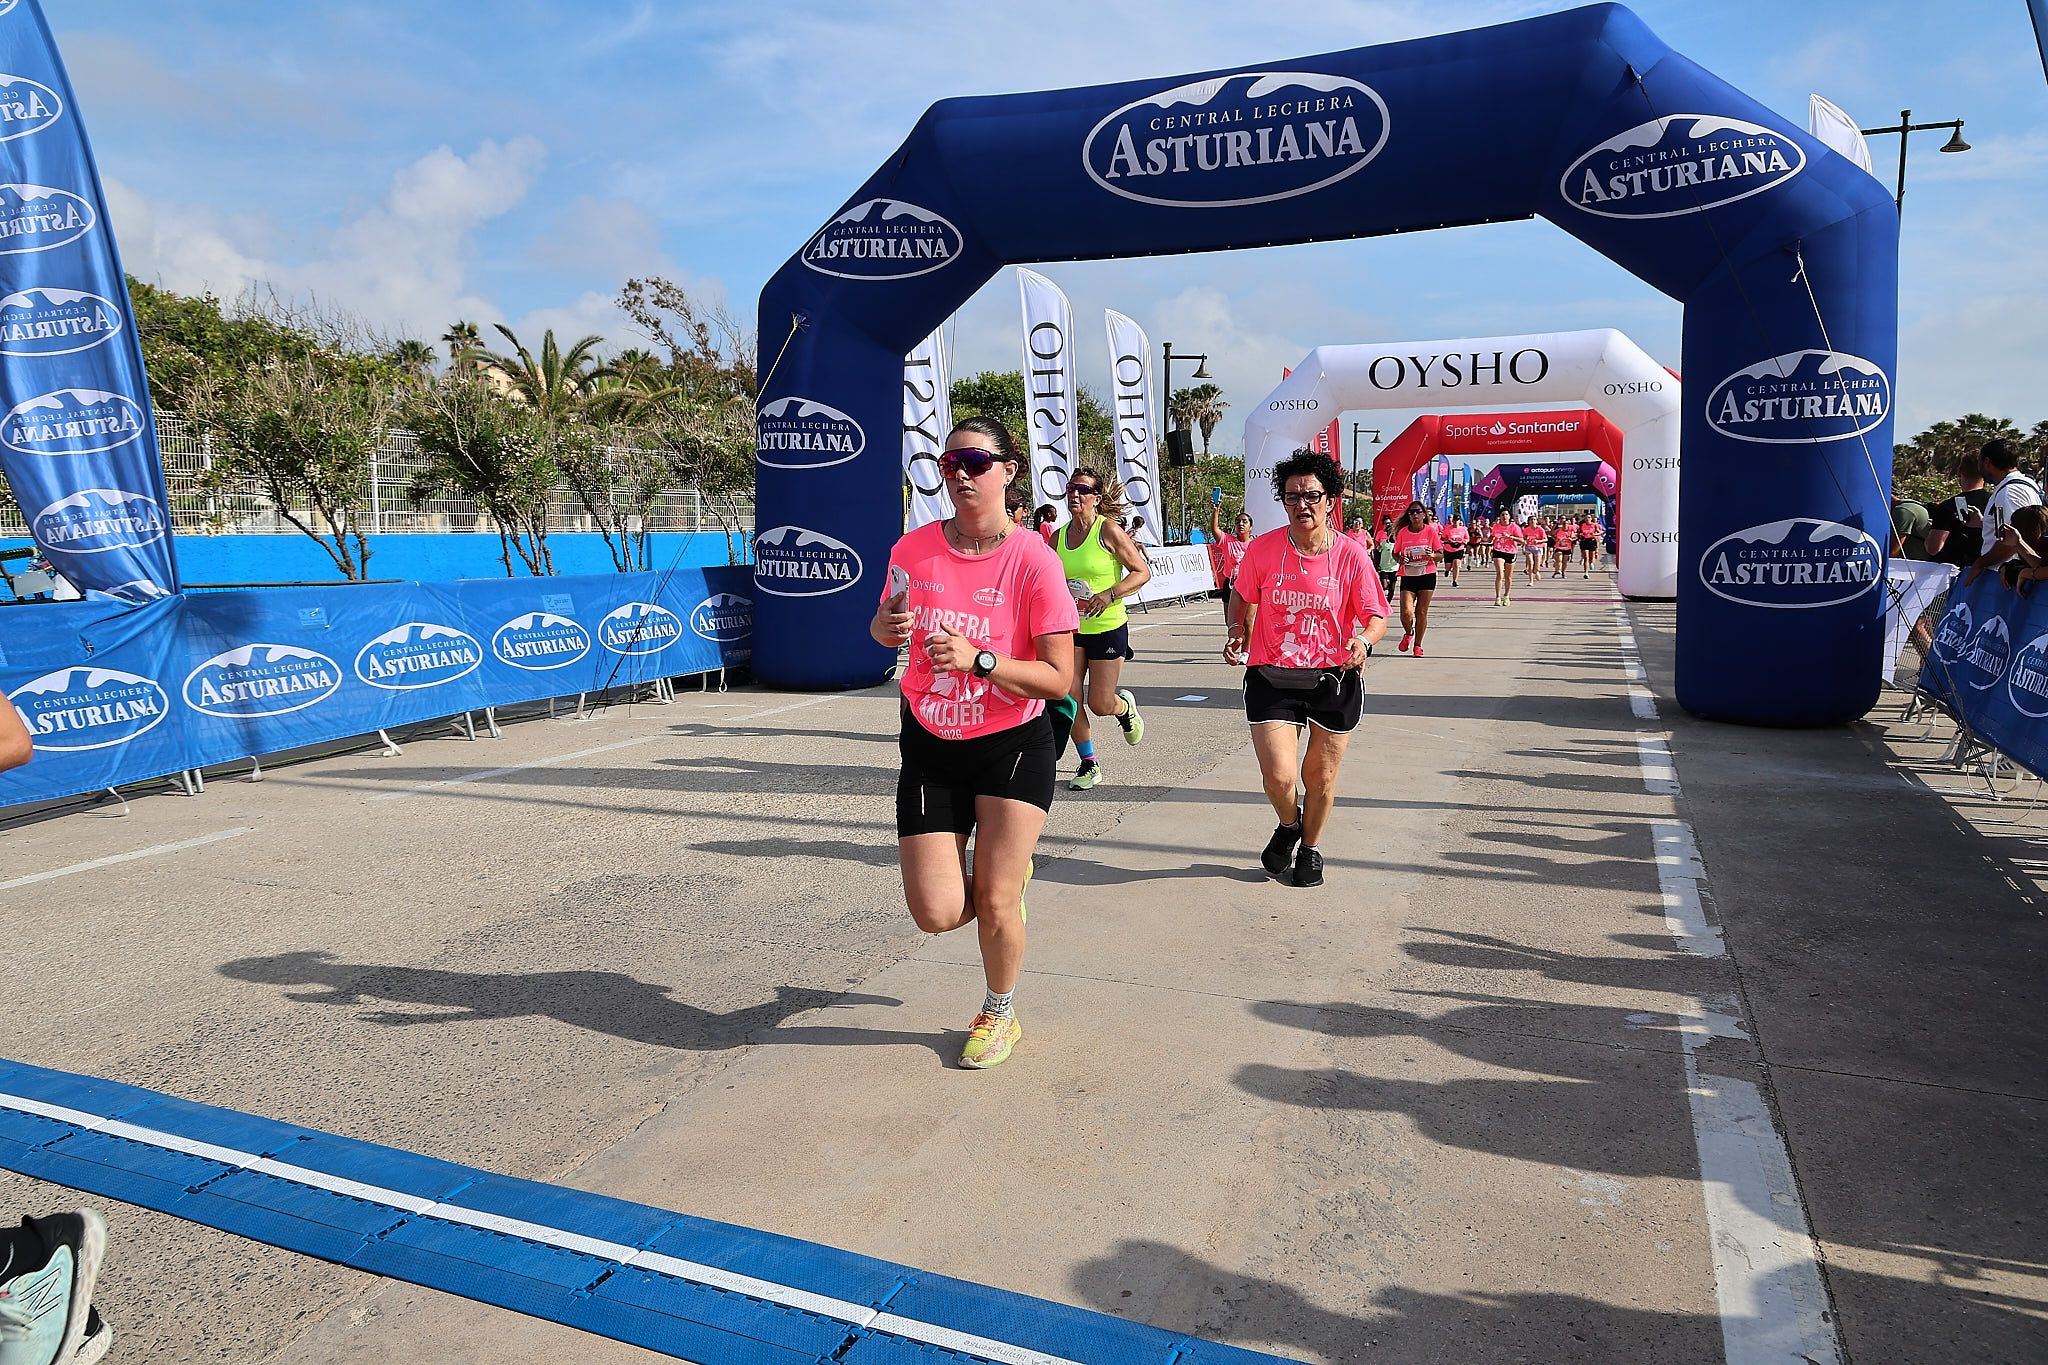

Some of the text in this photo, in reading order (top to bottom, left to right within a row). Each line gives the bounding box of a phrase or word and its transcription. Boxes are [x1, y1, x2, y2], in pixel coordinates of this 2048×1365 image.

[1150, 95, 1354, 131] CENTRAL LECHERA
[1105, 116, 1365, 178] ASTURIANA
[1609, 137, 1776, 171] CENTRAL LECHERA
[1580, 149, 1791, 204] ASTURIANA
[833, 225, 943, 236] CENTRAL LECHERA
[807, 233, 949, 260] ASTURIANA
[1368, 348, 1549, 390] OYSHO
[1604, 381, 1663, 396] OYSHO
[1747, 379, 1880, 395] CENTRAL LECHERA
[1269, 399, 1319, 411] OYSHO
[1716, 390, 1883, 425] ASTURIANA
[763, 421, 850, 431] CENTRAL LECHERA
[1445, 420, 1580, 439] Sports Santander
[761, 549, 848, 560] CENTRAL LECHERA
[1739, 546, 1871, 559] CENTRAL LECHERA
[1709, 551, 1874, 586] ASTURIANA
[912, 579, 945, 593] OYSHO
[1272, 589, 1330, 611] CARRERA
[699, 612, 753, 632] ASTURIAN
[912, 605, 991, 642] CARRERA
[512, 628, 578, 640] CENTRAL LECHERA
[383, 639, 467, 657] CENTRAL LECHERA
[503, 635, 586, 659] ASTURIANA
[219, 660, 323, 681] CENTRAL LECHERA
[367, 647, 476, 680] ASTURIANA
[33, 686, 151, 710] CENTRAL LECHERA
[199, 670, 334, 707] ASTURIANA
[920, 694, 985, 727] MUJER
